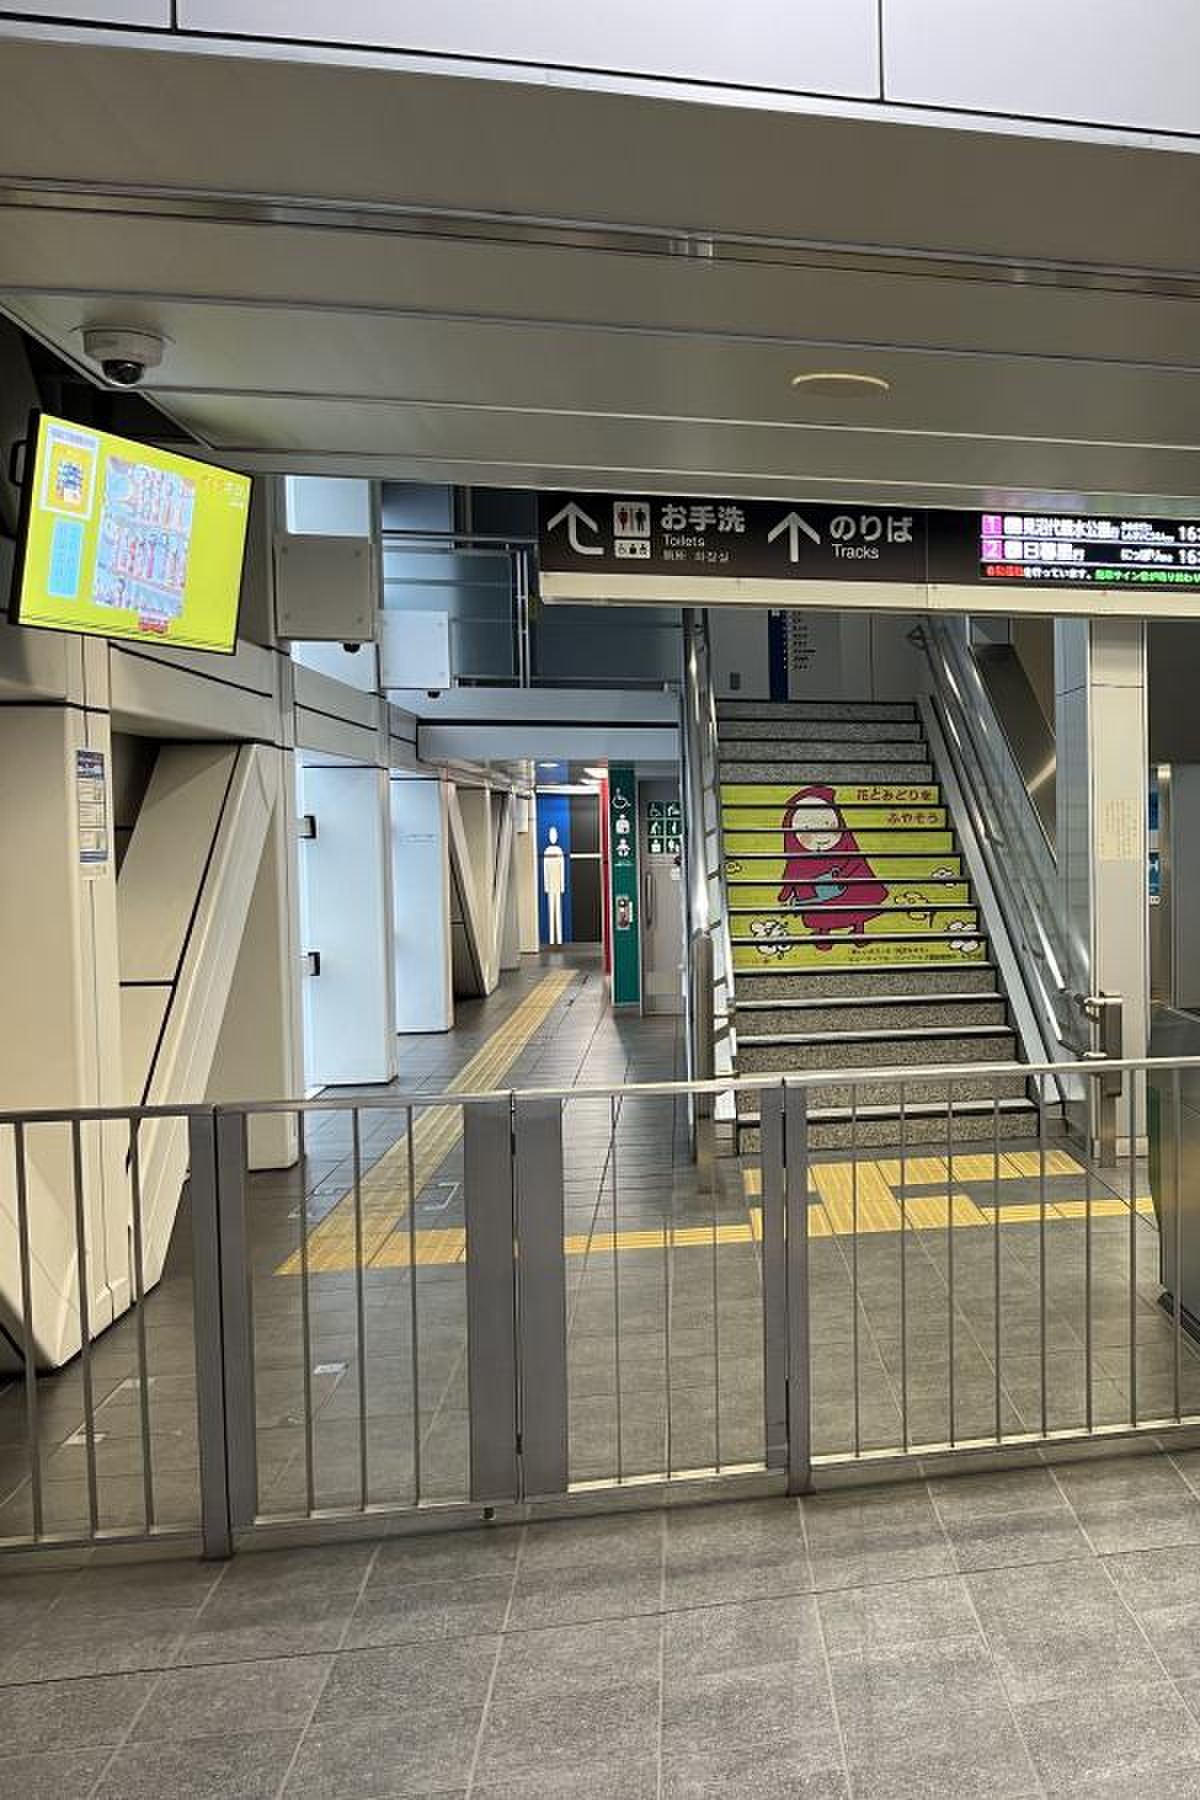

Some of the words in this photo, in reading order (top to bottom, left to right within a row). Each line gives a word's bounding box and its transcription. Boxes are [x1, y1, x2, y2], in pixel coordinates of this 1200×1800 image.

[661, 503, 746, 533] お手洗
[830, 514, 913, 543] のりば
[832, 543, 880, 559] Tracks
